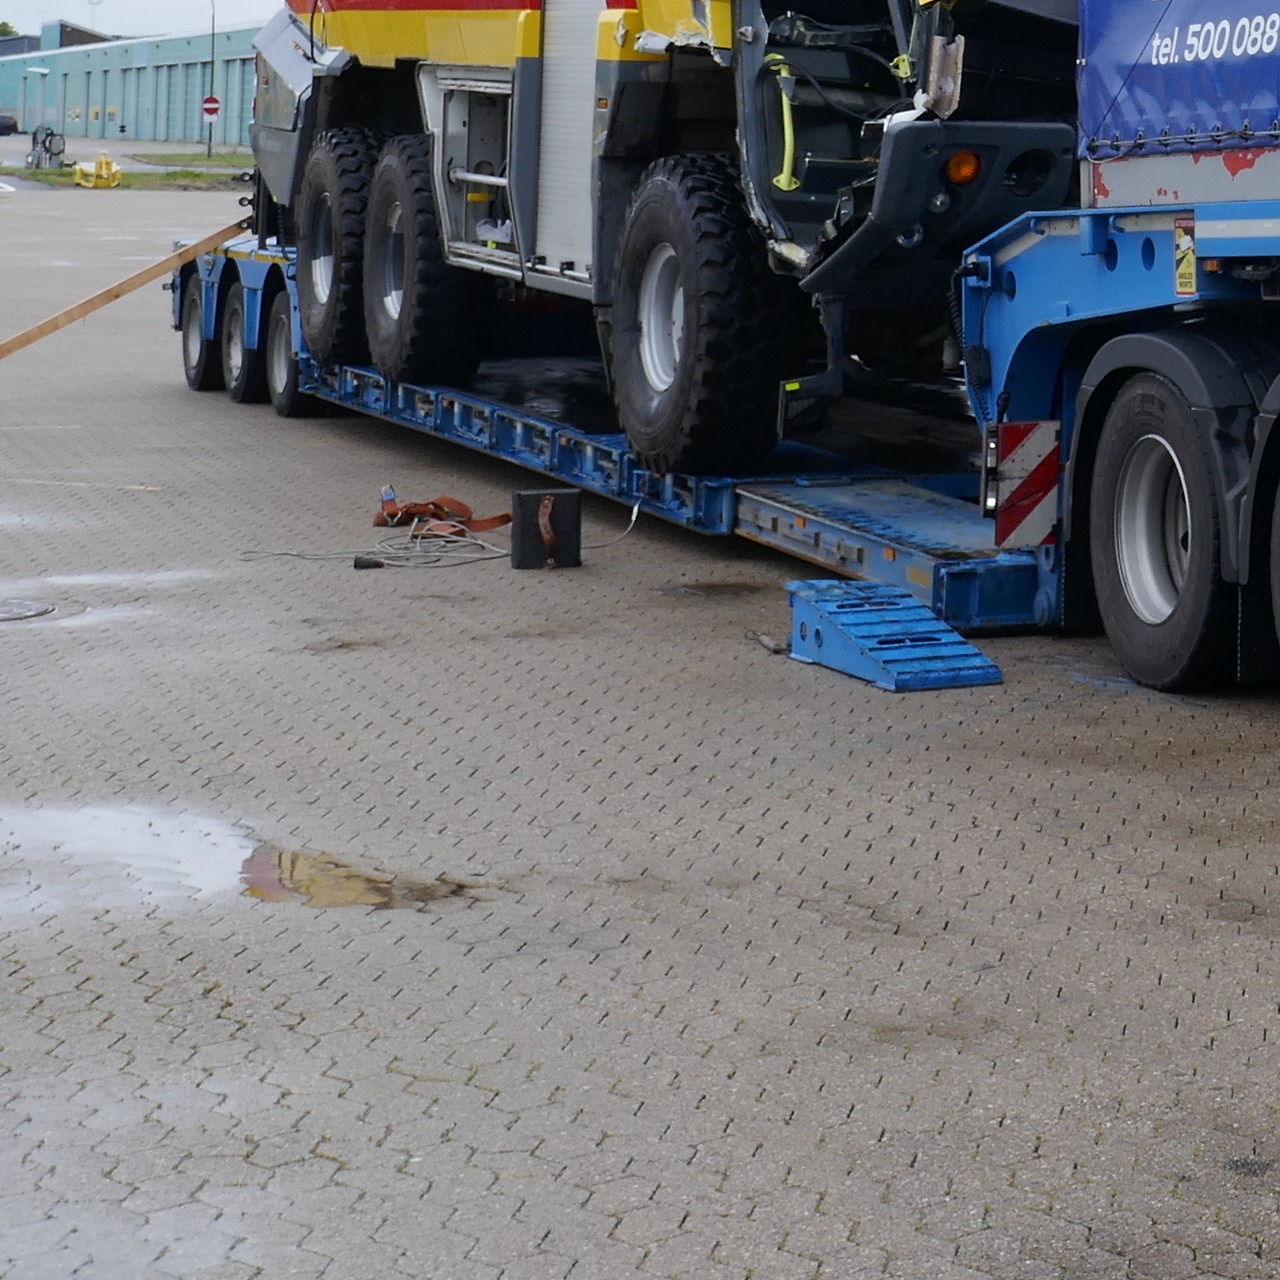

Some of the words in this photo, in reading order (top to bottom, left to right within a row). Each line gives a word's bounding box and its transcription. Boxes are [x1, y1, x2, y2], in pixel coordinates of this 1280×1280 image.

[1151, 26, 1179, 66] tel.
[1184, 19, 1230, 62] 500
[1232, 13, 1280, 57] 088
